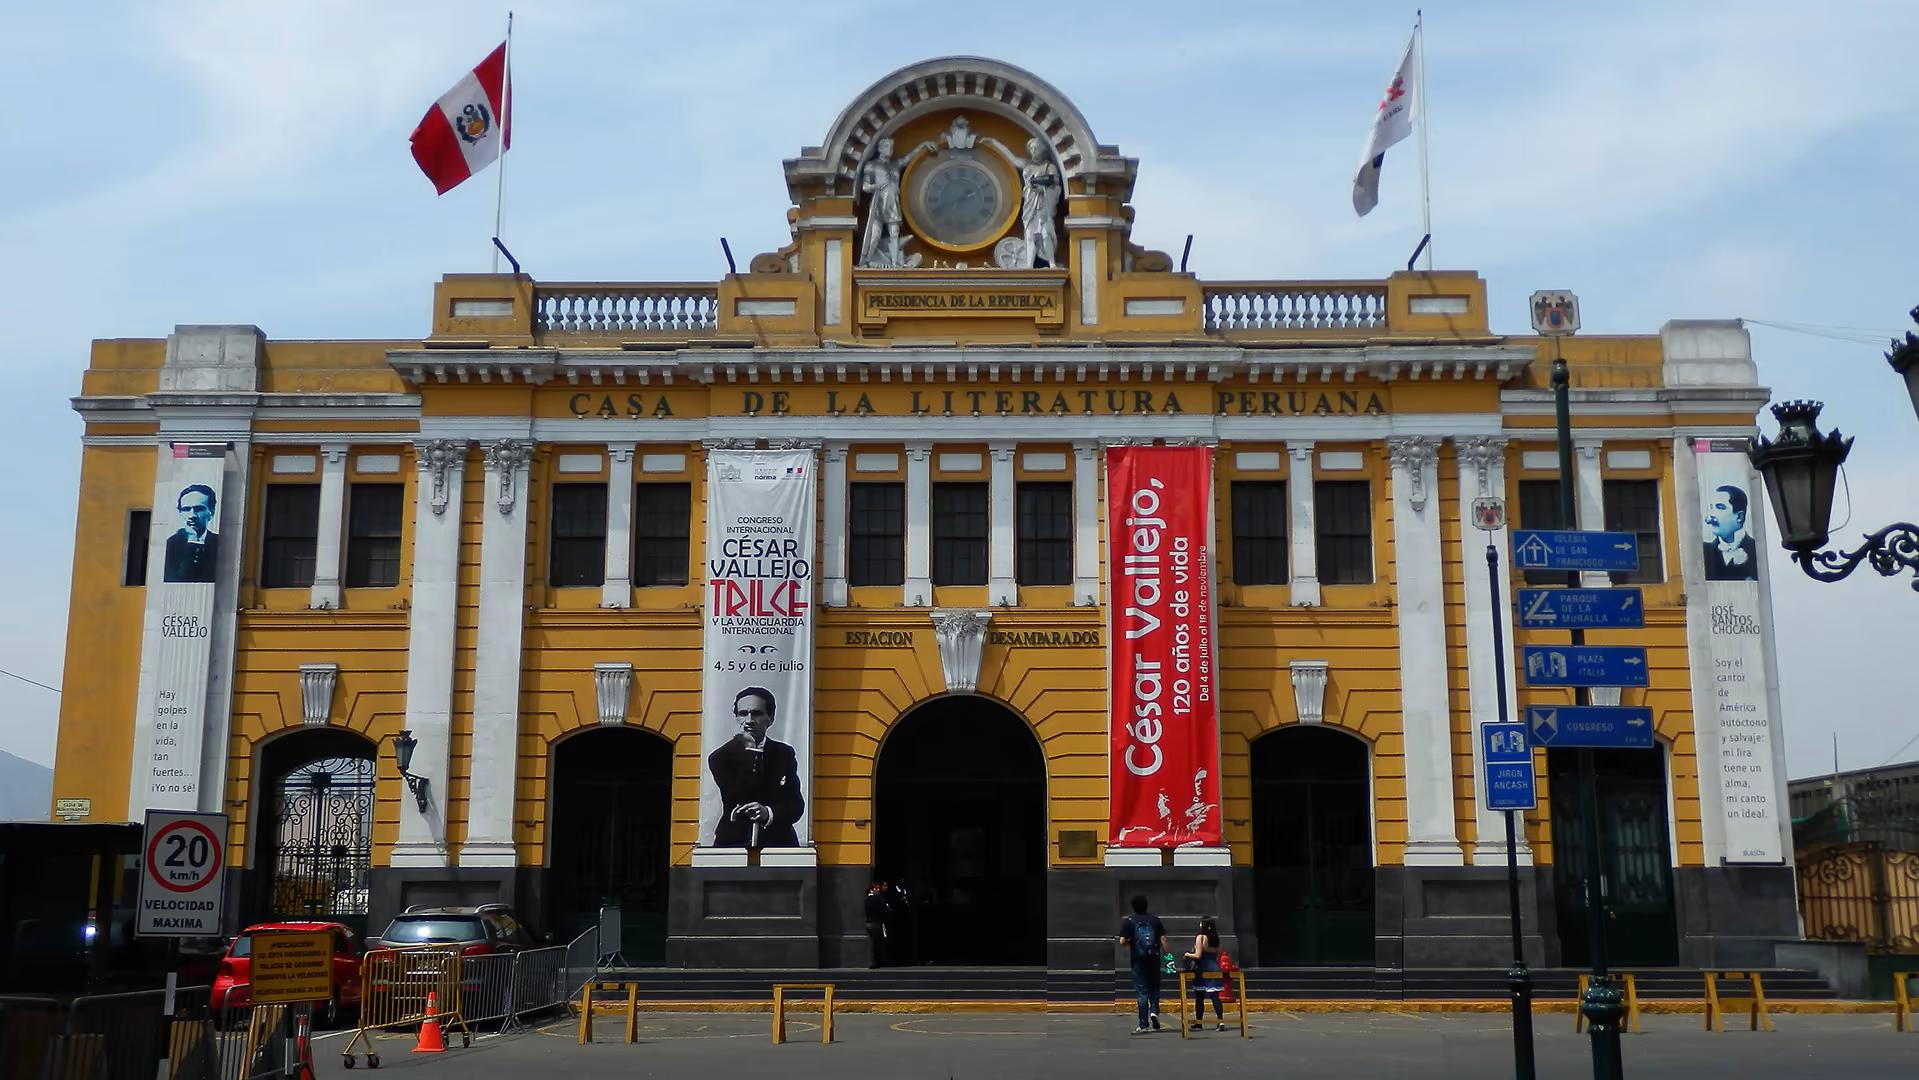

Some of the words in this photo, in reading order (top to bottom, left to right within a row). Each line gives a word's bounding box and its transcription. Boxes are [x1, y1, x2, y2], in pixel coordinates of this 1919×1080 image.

[869, 295, 946, 308] PRESIDENCIA
[950, 295, 966, 307] DE
[969, 296, 985, 307] LA
[988, 295, 1053, 307] REPUBLICA
[569, 392, 674, 416] CASA
[742, 391, 791, 414] DE
[826, 391, 875, 414] LA
[910, 390, 1184, 414] LITERATURA
[1216, 390, 1386, 414] PERUANA
[737, 516, 784, 525] CONGRESO
[726, 526, 795, 534] INTERNACIONAL
[722, 536, 799, 558] CÉSAR
[1555, 546, 1568, 555] DE
[1570, 546, 1588, 555] SAN
[1124, 477, 1167, 639] Vallejo,
[1169, 537, 1188, 584] vida
[710, 559, 812, 581] VALLEJO,
[1198, 545, 1208, 596] noviembre
[709, 579, 809, 617] TRILCE
[1560, 594, 1599, 603] PARQUE
[1170, 590, 1189, 618] de
[1198, 597, 1207, 612] de
[1561, 604, 1574, 612] DE
[1579, 604, 1592, 613] LA
[1711, 602, 1735, 616] JOSÉ
[163, 613, 199, 627] CÉSAR
[712, 617, 720, 626] Y
[721, 617, 734, 626] LA
[736, 617, 805, 627] VANGUARDIA
[1711, 614, 1753, 626] SANTOS
[162, 626, 208, 638] VALLEJO
[722, 627, 795, 635] INTERNACIONAL
[1199, 625, 1208, 637] al
[1712, 625, 1760, 635] CHOCANO
[845, 631, 913, 645] ESTACION
[990, 631, 1099, 645] DESAMPARADOS
[1172, 623, 1190, 673] años
[1199, 637, 1209, 659] julio
[1577, 654, 1605, 664] PLAZA
[1715, 658, 1731, 669] Soy
[1734, 658, 1743, 667] el
[714, 661, 725, 672] 4,
[728, 661, 735, 671] 5
[738, 664, 746, 674] y
[750, 661, 757, 671] 6
[761, 660, 776, 672] de
[778, 660, 804, 673] julio
[1199, 660, 1209, 674] de
[1578, 668, 1606, 677] ITALIA
[1200, 676, 1209, 684] 4
[1716, 674, 1745, 682] cantor
[159, 690, 176, 701] Hay
[1173, 679, 1191, 715] 120
[1199, 686, 1209, 701] Del
[1717, 688, 1729, 697] de
[157, 705, 188, 717] golpes
[1719, 702, 1756, 712] América
[1124, 653, 1164, 776] César
[156, 722, 168, 730] en
[169, 721, 179, 730] la
[1566, 722, 1614, 732] CONGRESO
[155, 737, 177, 748] vida,
[1721, 735, 1727, 744] y
[153, 753, 169, 761] tan
[1722, 748, 1734, 757] mi
[1736, 748, 1752, 757] lira
[152, 767, 193, 777] fuertes...
[1496, 769, 1523, 778] JIRON
[1723, 763, 1747, 773] tiene
[1750, 765, 1762, 773] un
[168, 785, 180, 793] no
[1494, 781, 1528, 790] ANCASH
[1725, 779, 1751, 789] alma,
[1726, 795, 1738, 803] mi
[1740, 795, 1766, 803] canto
[1727, 811, 1739, 819] un
[1741, 809, 1768, 819] ideal.
[164, 834, 209, 868] 20
[169, 870, 200, 881] km/h
[144, 899, 214, 911] VELOCIDAD
[152, 917, 203, 929] MAXIMA
